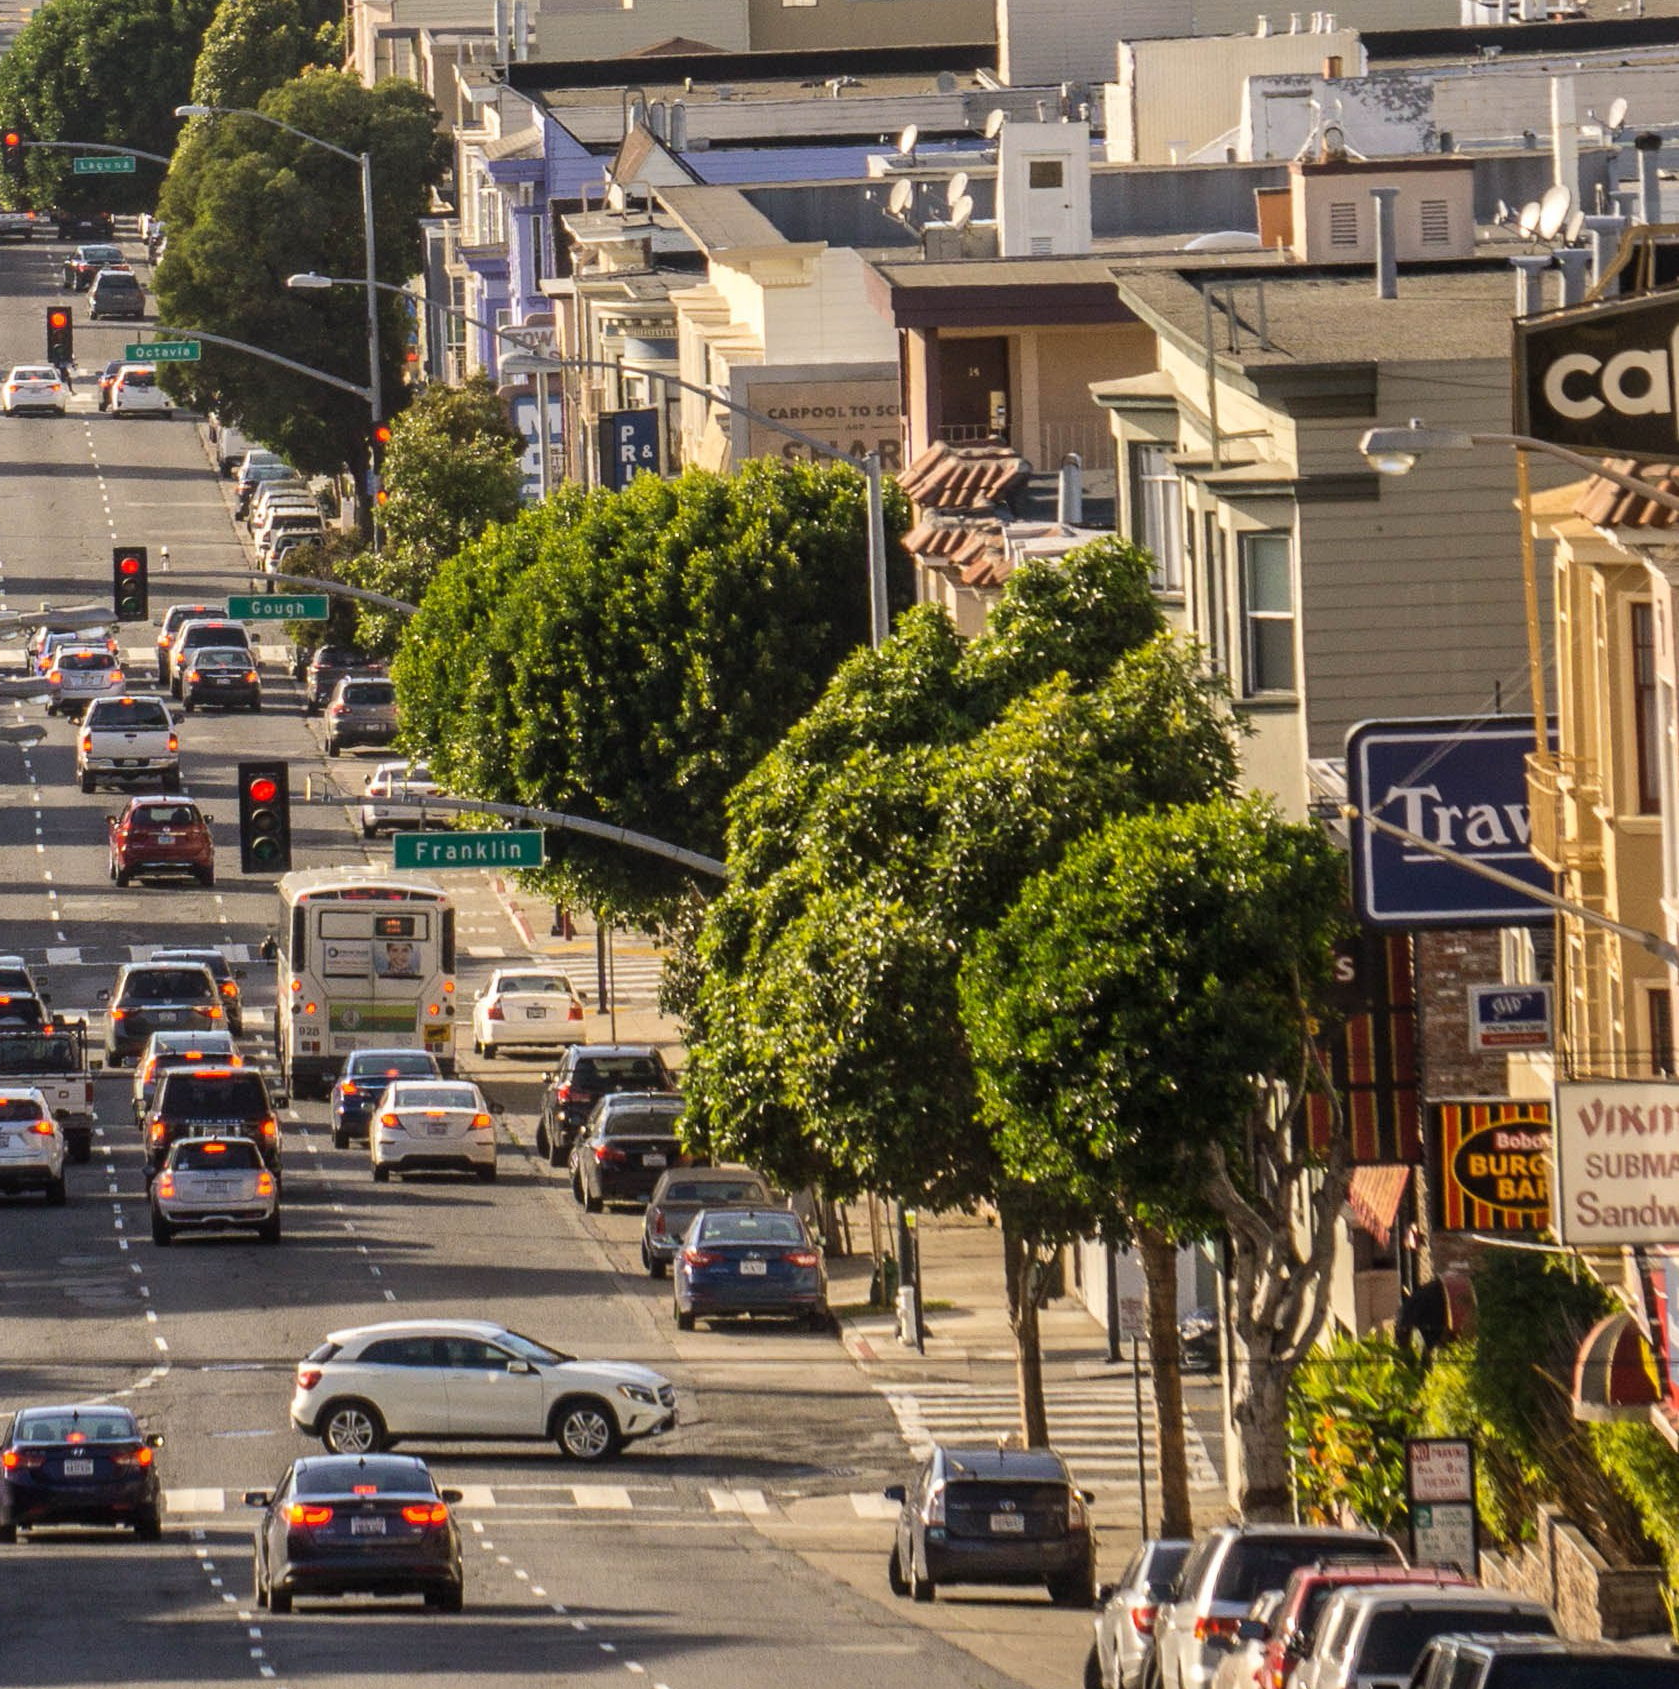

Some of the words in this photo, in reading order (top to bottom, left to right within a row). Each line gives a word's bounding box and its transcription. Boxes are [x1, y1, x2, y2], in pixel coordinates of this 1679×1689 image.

[80, 161, 129, 171] Laguna
[135, 347, 191, 358] Octavia
[1544, 322, 1679, 438] ca
[767, 406, 845, 420] CARPOOL
[849, 406, 871, 418] TO
[642, 444, 653, 459] &
[251, 600, 305, 618] Gough
[415, 840, 521, 861] Franklin
